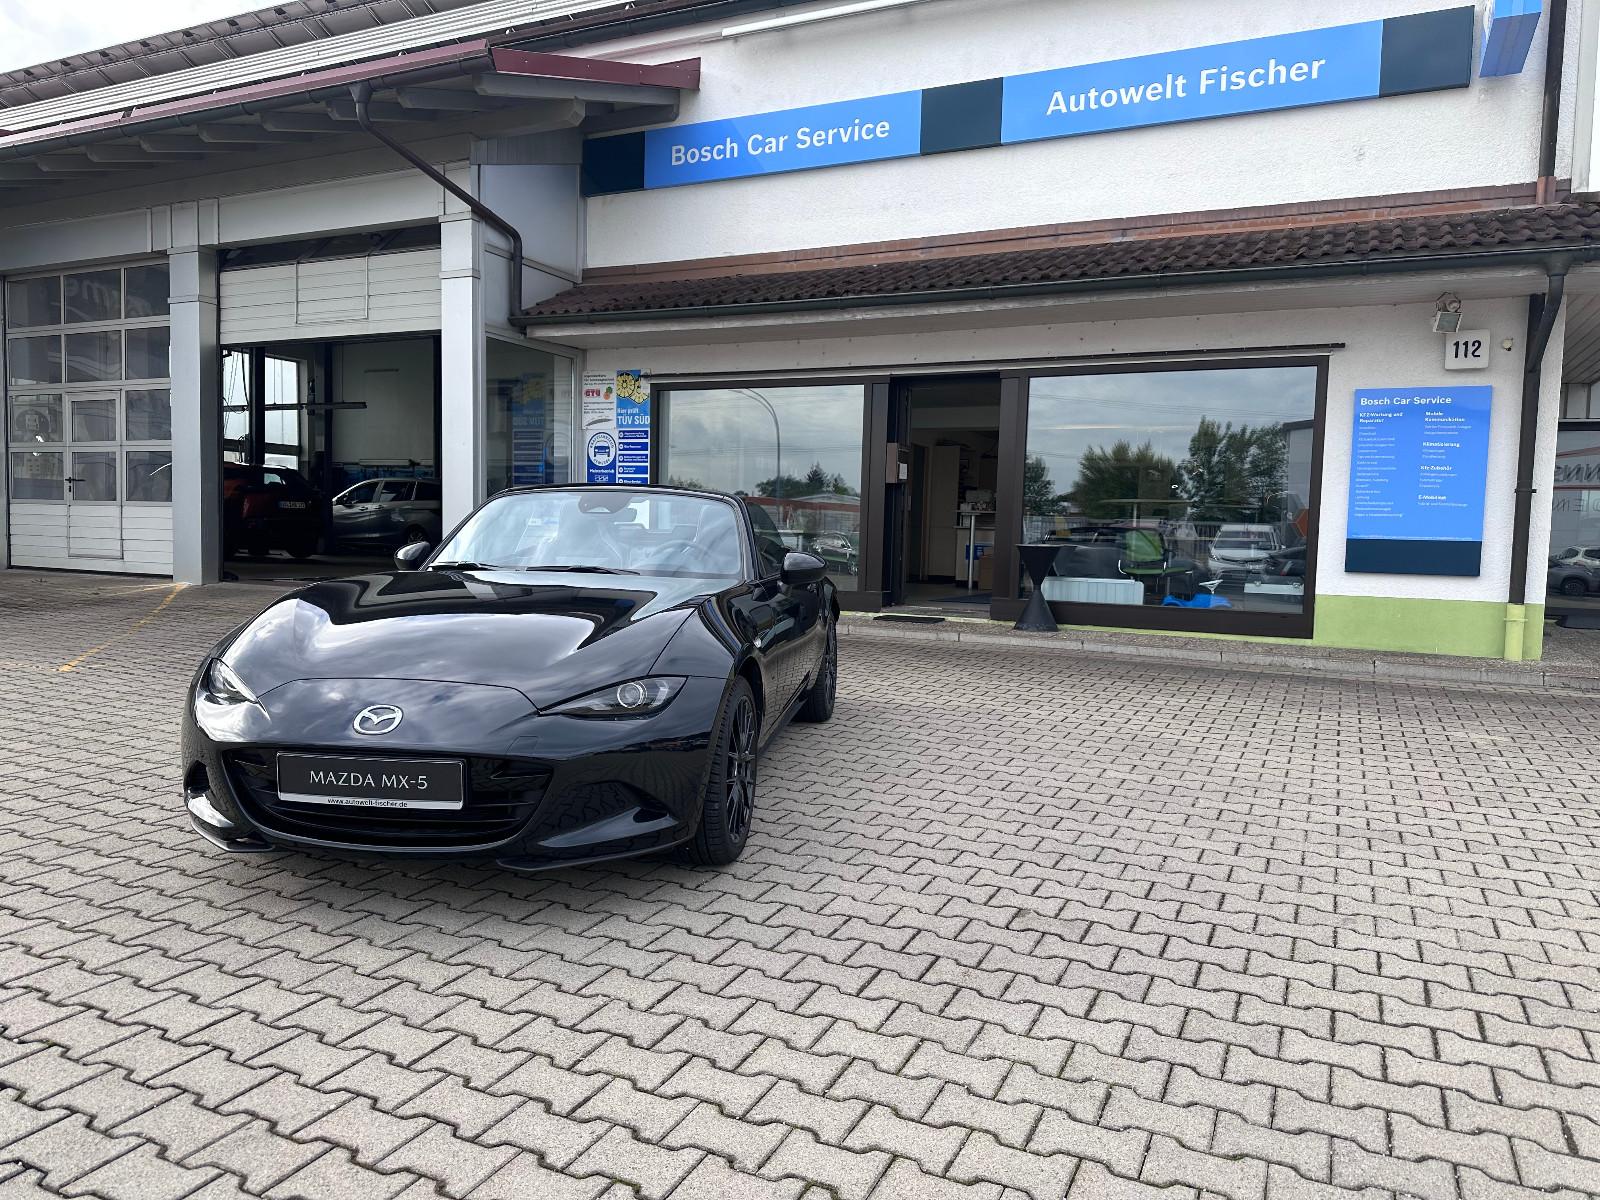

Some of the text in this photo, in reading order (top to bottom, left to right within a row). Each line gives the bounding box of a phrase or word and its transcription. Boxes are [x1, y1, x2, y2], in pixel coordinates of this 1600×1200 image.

[1046, 58, 1326, 116] Autowelt Fischer
[671, 118, 890, 166] Bosch Car Service
[1453, 340, 1482, 359] 112
[1360, 396, 1452, 406] Bosch Car Service
[618, 413, 650, 425] TÜV SÜD
[309, 770, 428, 790] MAZDA MX-5
[327, 798, 408, 808] www.autowelt-fischer.de
